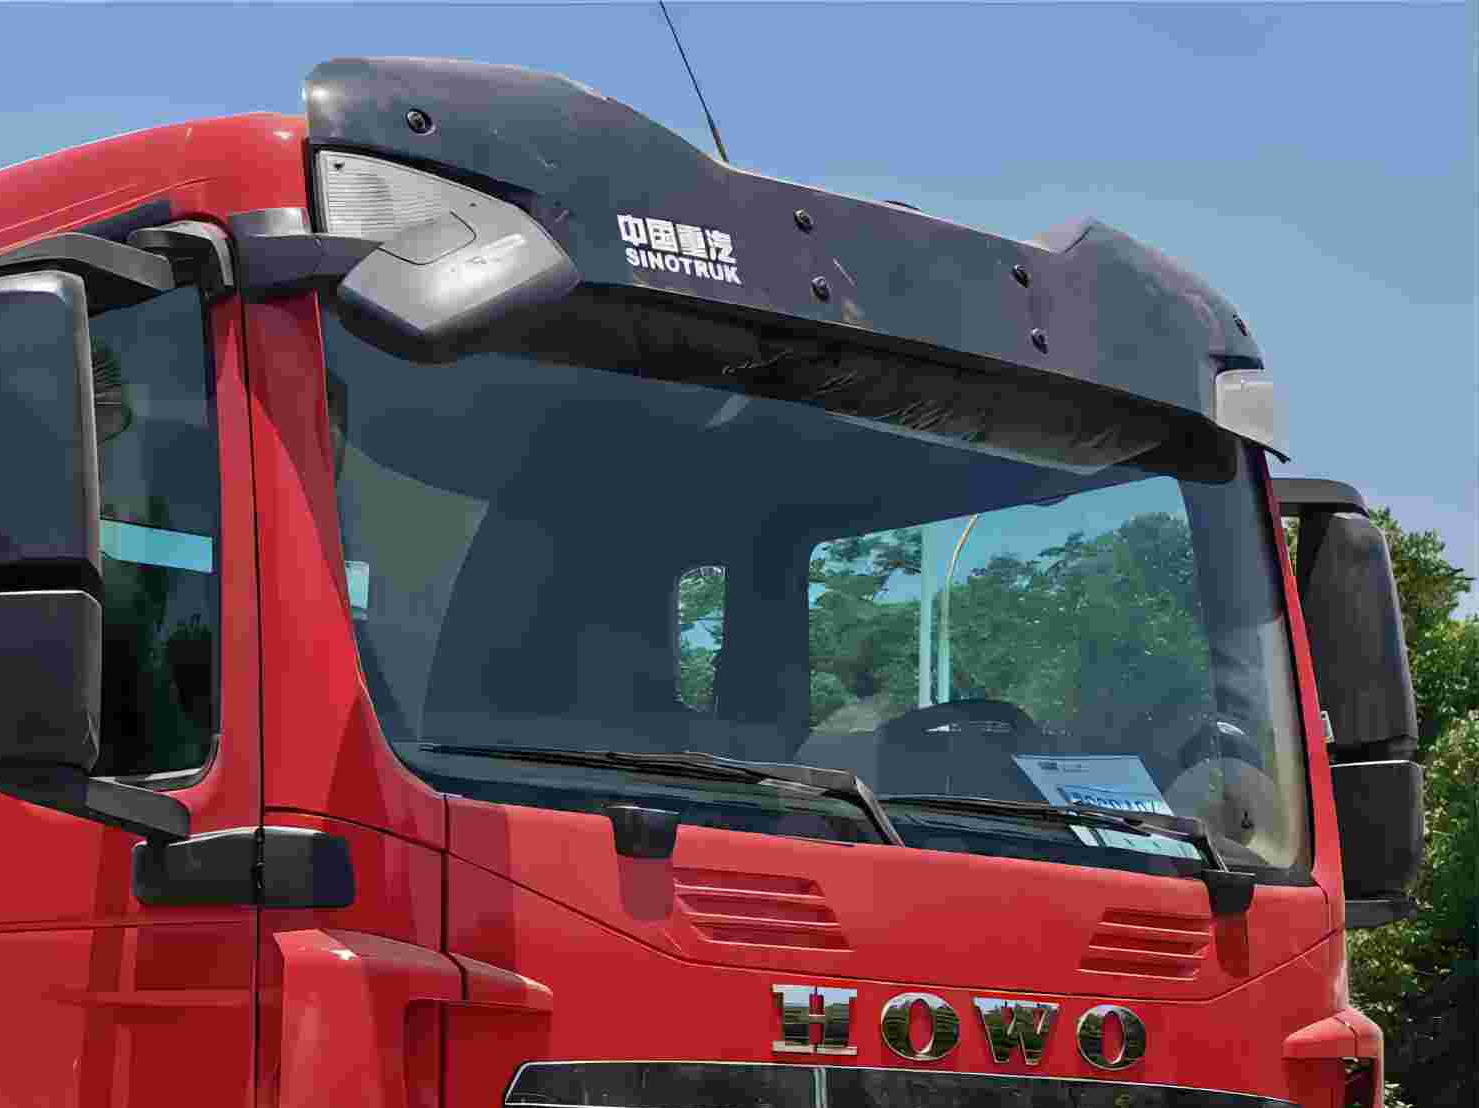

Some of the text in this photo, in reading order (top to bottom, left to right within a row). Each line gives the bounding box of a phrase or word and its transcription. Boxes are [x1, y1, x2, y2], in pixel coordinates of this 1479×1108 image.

[616, 214, 737, 264] 中国重汽
[624, 247, 744, 286] SINOTRUK
[771, 983, 1148, 1071] HOWO
